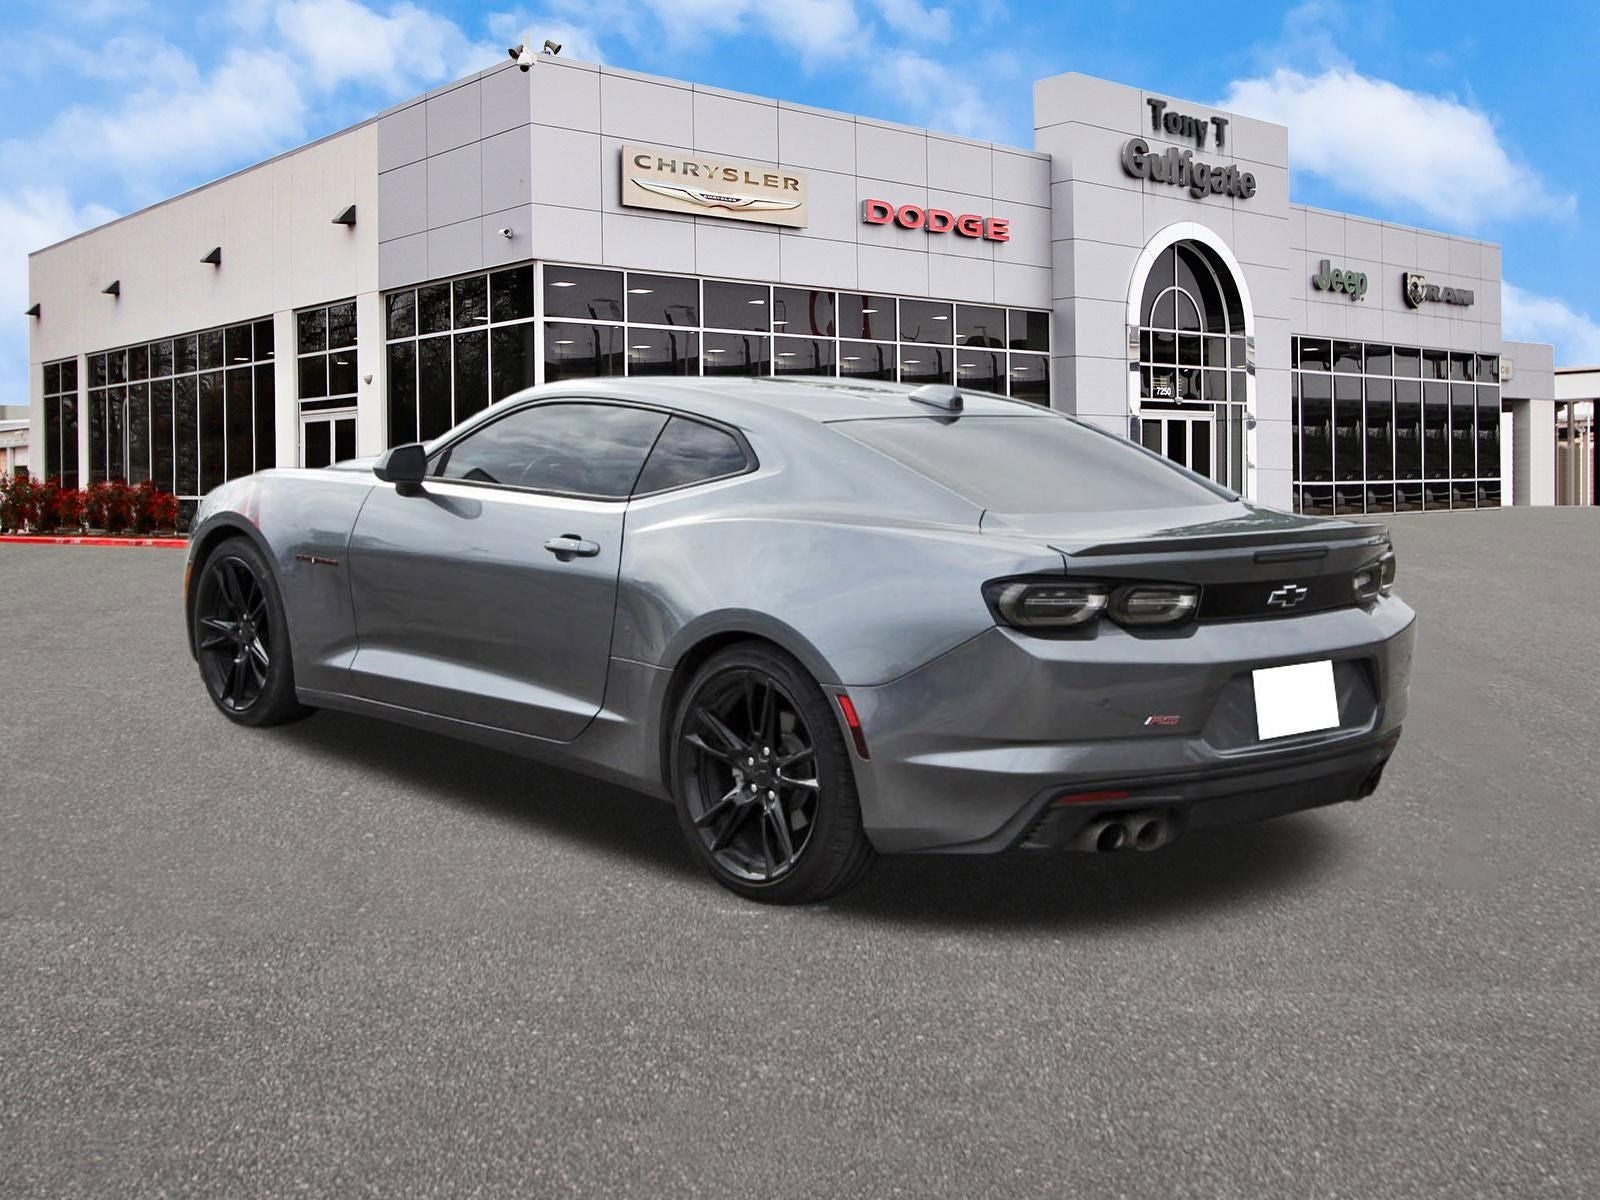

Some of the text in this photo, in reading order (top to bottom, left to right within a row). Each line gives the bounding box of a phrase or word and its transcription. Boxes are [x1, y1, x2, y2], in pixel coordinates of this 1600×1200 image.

[1147, 98, 1229, 148] Tony T
[633, 154, 800, 192] CHRYSLER
[1121, 138, 1256, 199] Gulfgate
[862, 198, 1010, 243] DODGE
[1312, 259, 1368, 302] Jeep
[1424, 283, 1474, 306] RAM
[1156, 386, 1172, 396] 7250
